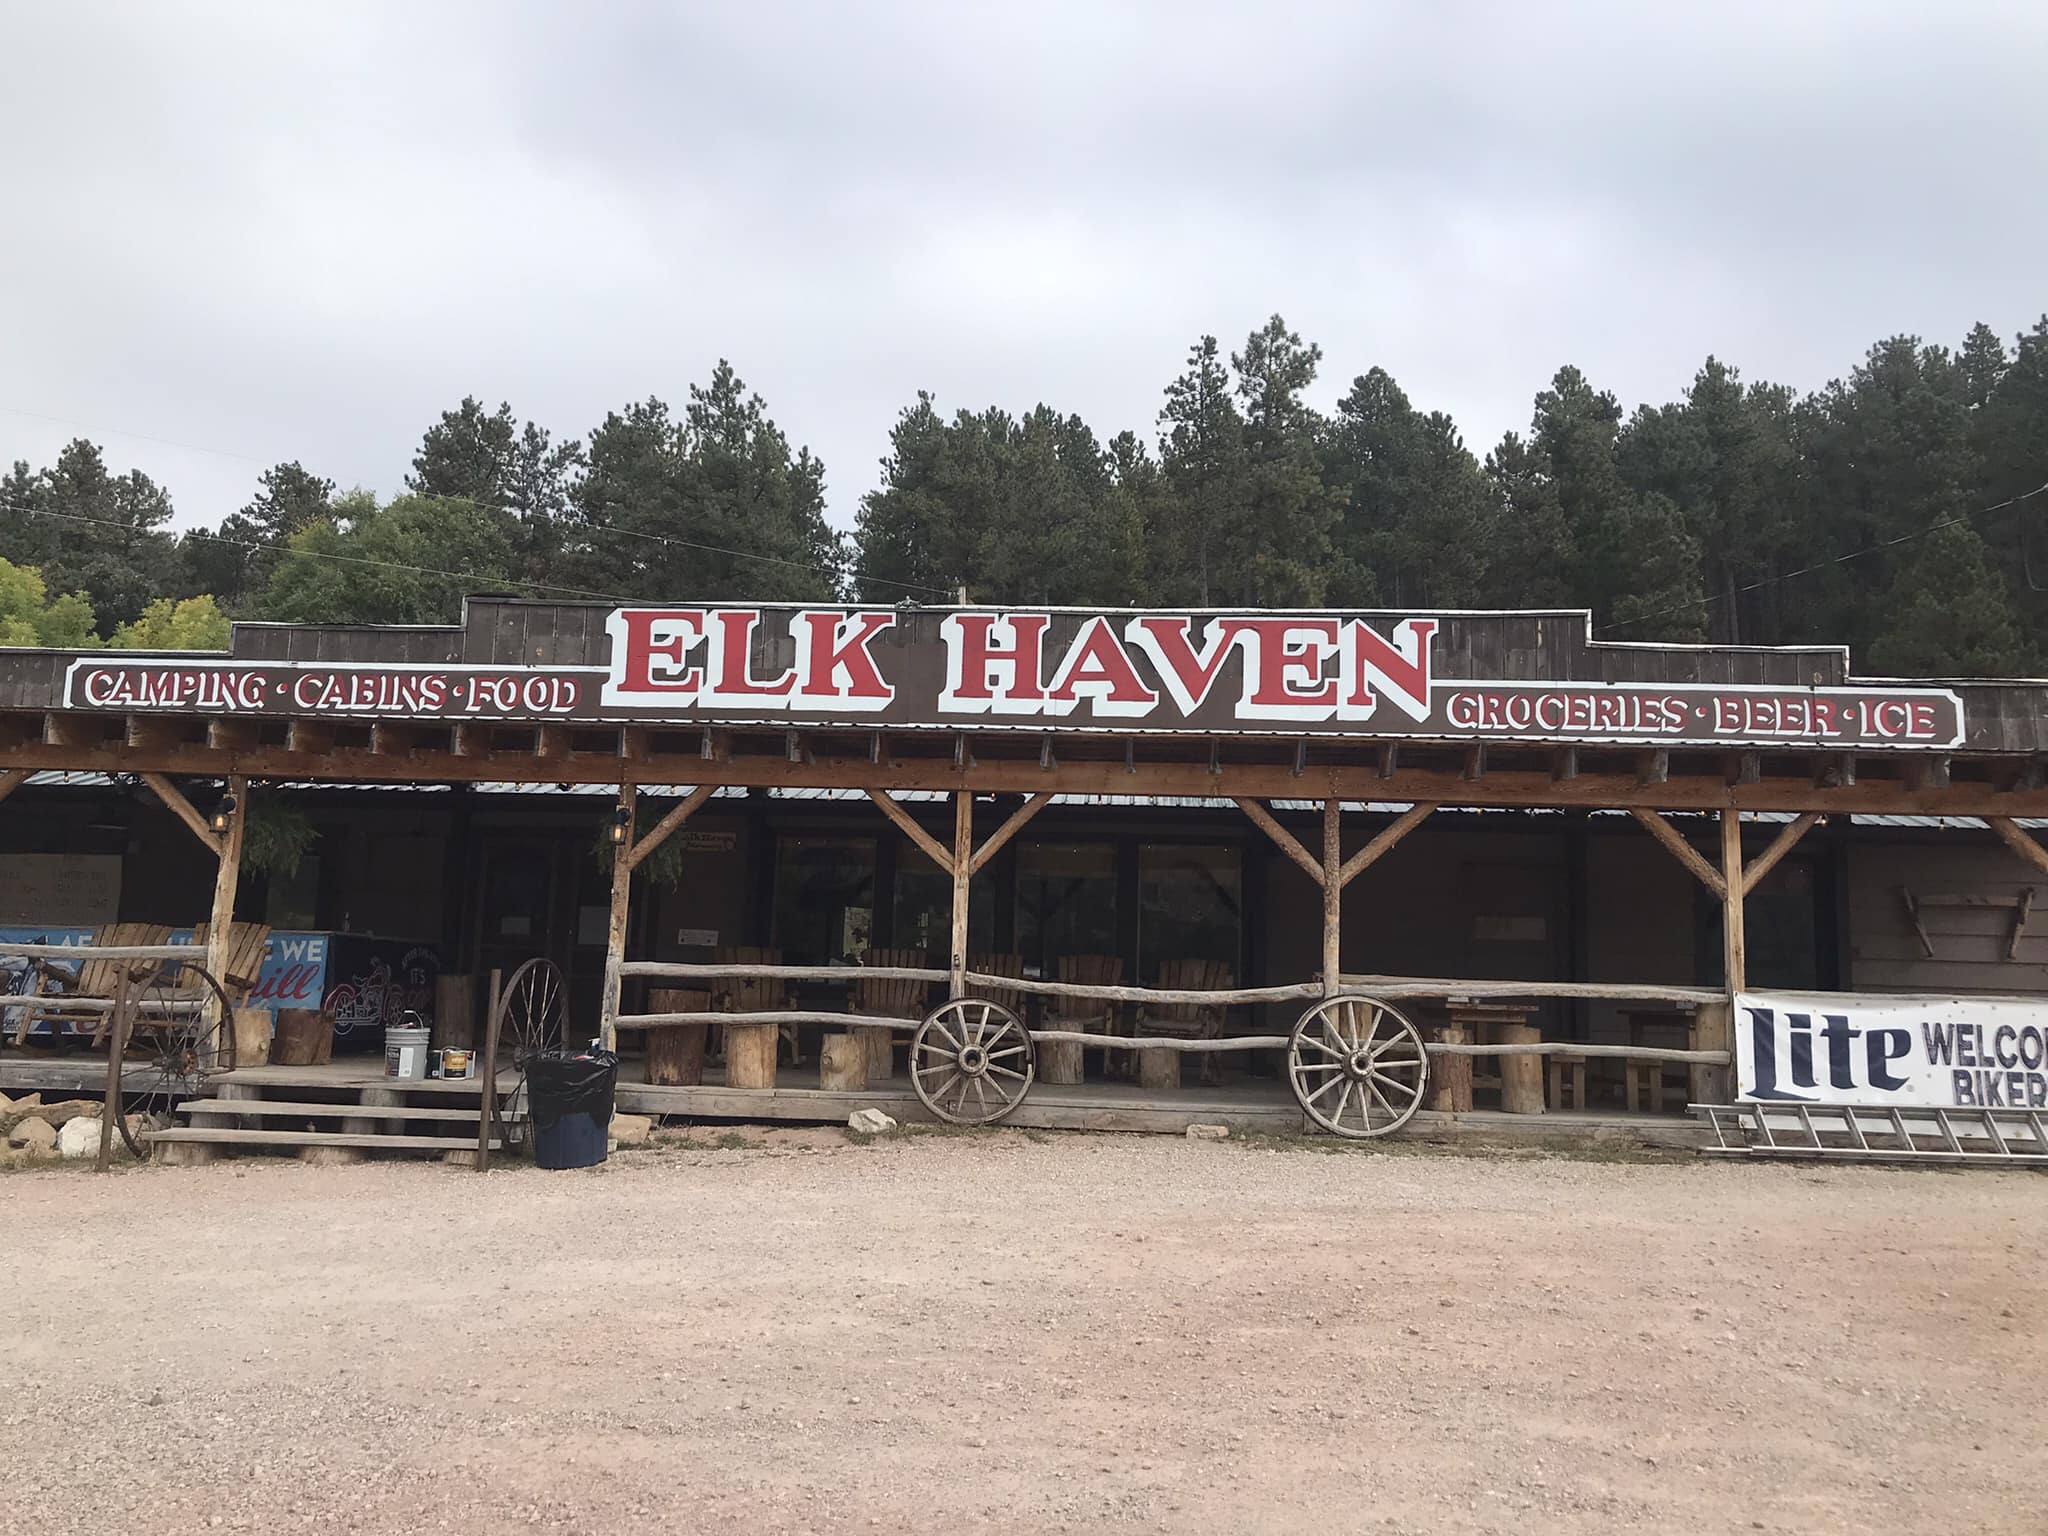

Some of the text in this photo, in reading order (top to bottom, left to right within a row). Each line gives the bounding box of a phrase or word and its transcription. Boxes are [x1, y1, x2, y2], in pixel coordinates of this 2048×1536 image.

[601, 608, 1441, 725] ELK HAVEN
[84, 669, 581, 713] CAMPING CABINS FOOD
[1446, 692, 1937, 739] GROCERIES BEER ICE
[281, 939, 323, 962] WE
[1922, 1021, 2048, 1071] WELCO
